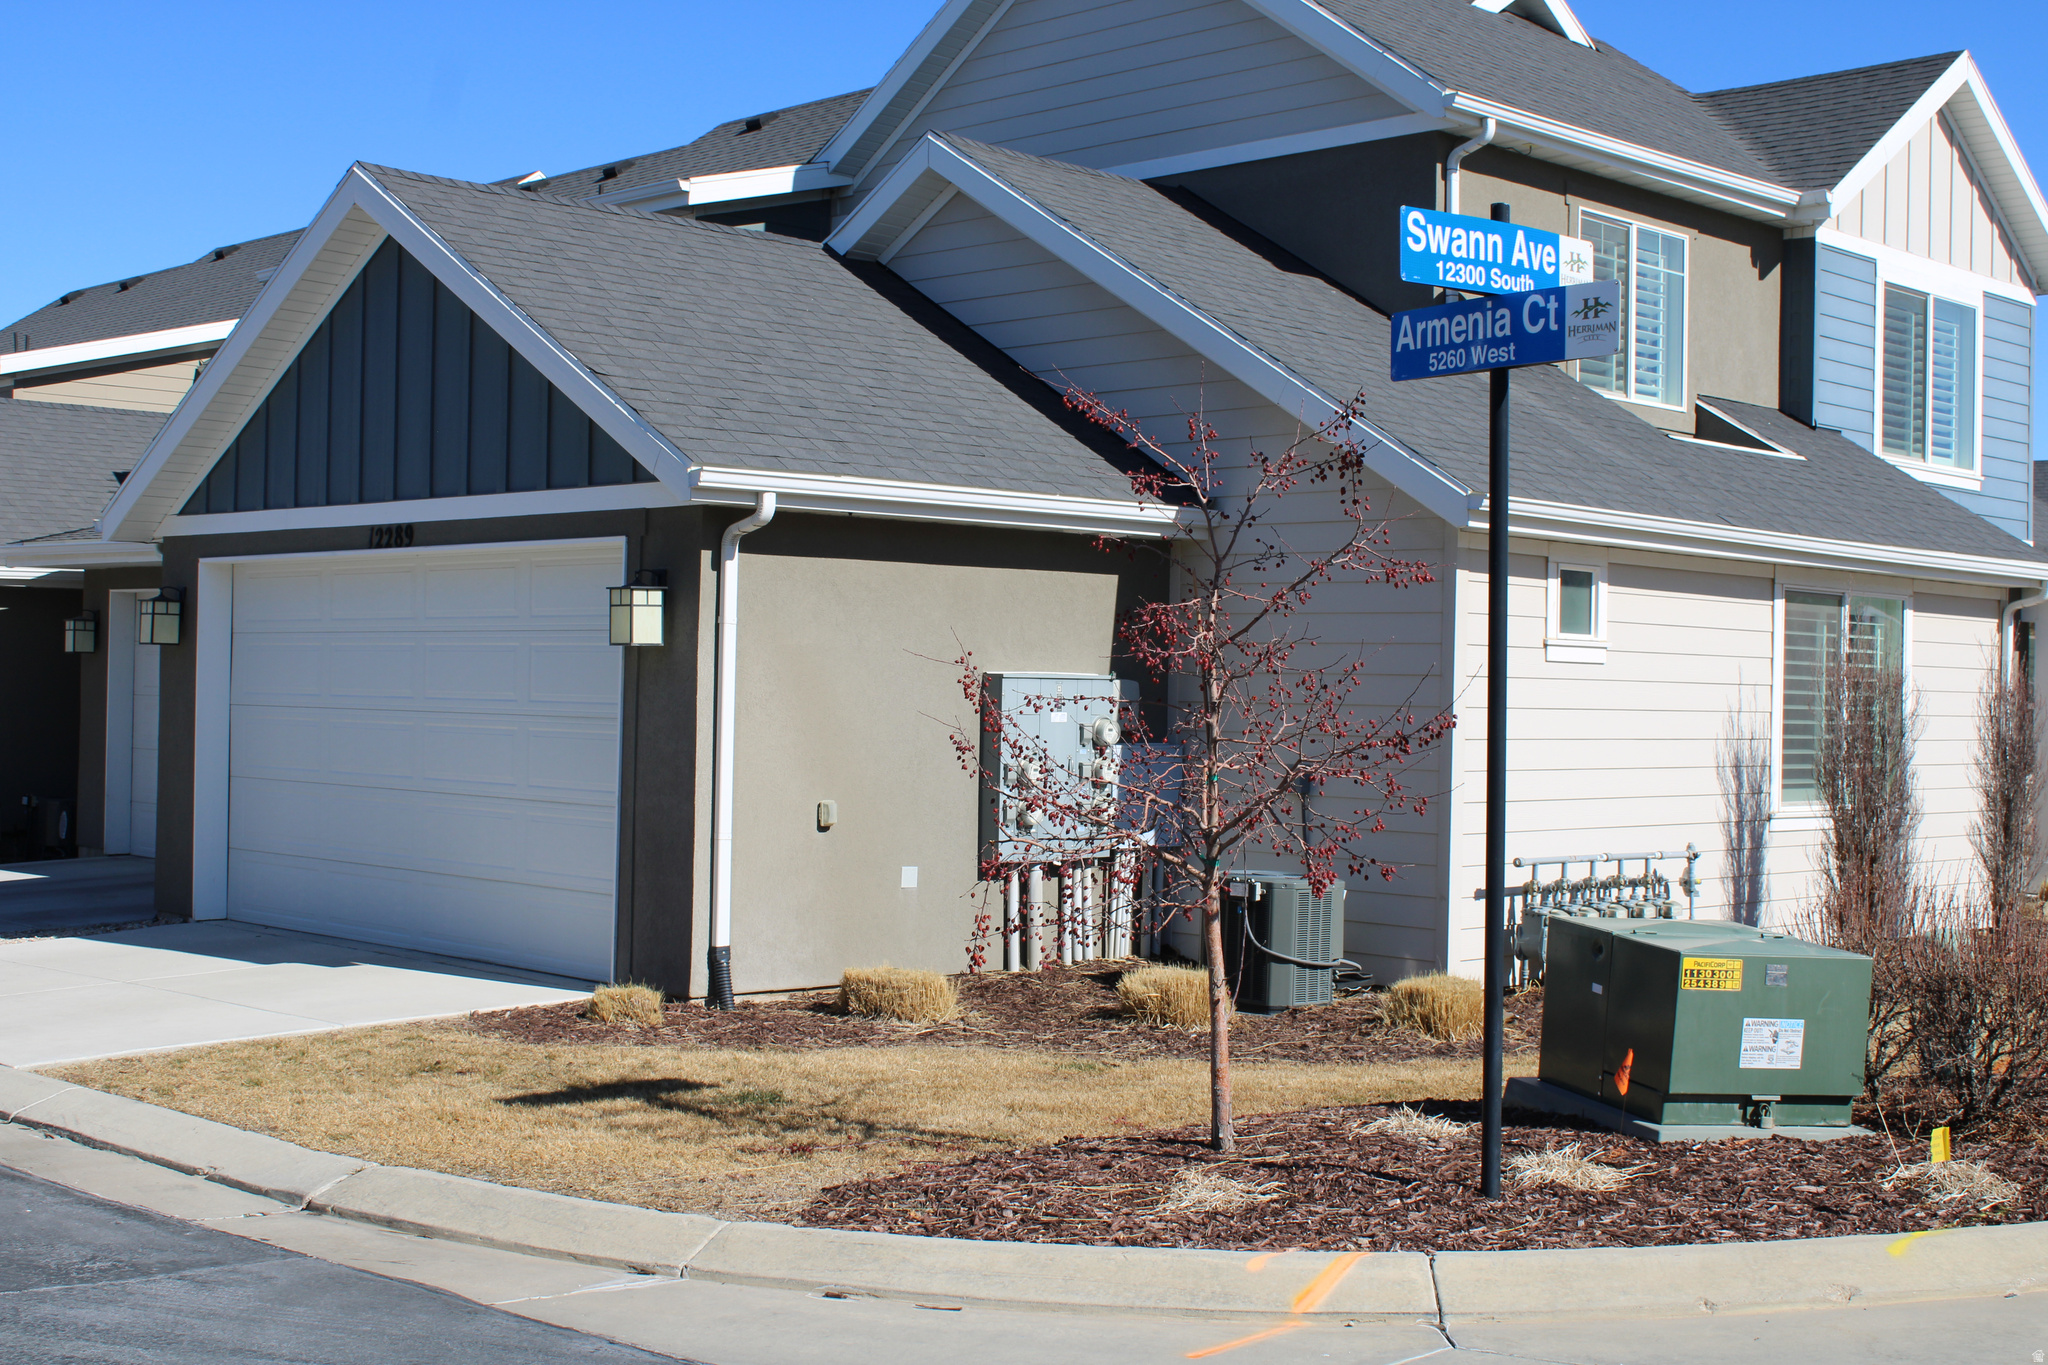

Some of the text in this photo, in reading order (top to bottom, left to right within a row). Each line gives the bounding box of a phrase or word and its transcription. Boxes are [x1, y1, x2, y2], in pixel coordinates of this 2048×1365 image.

[1407, 210, 1557, 275] Swann Ave
[1436, 260, 1535, 292] 12300 South
[1396, 293, 1559, 352] Armenia Ct
[1567, 320, 1617, 338] HERRIMAN
[1583, 334, 1600, 342] CITY
[1428, 342, 1516, 372] 5260 West
[369, 523, 415, 549] 12289
[1686, 969, 1733, 979] 1130300
[1684, 980, 1726, 989] 254389
[1751, 1020, 1779, 1028] WARNING
[1749, 1045, 1777, 1053] WARNING
